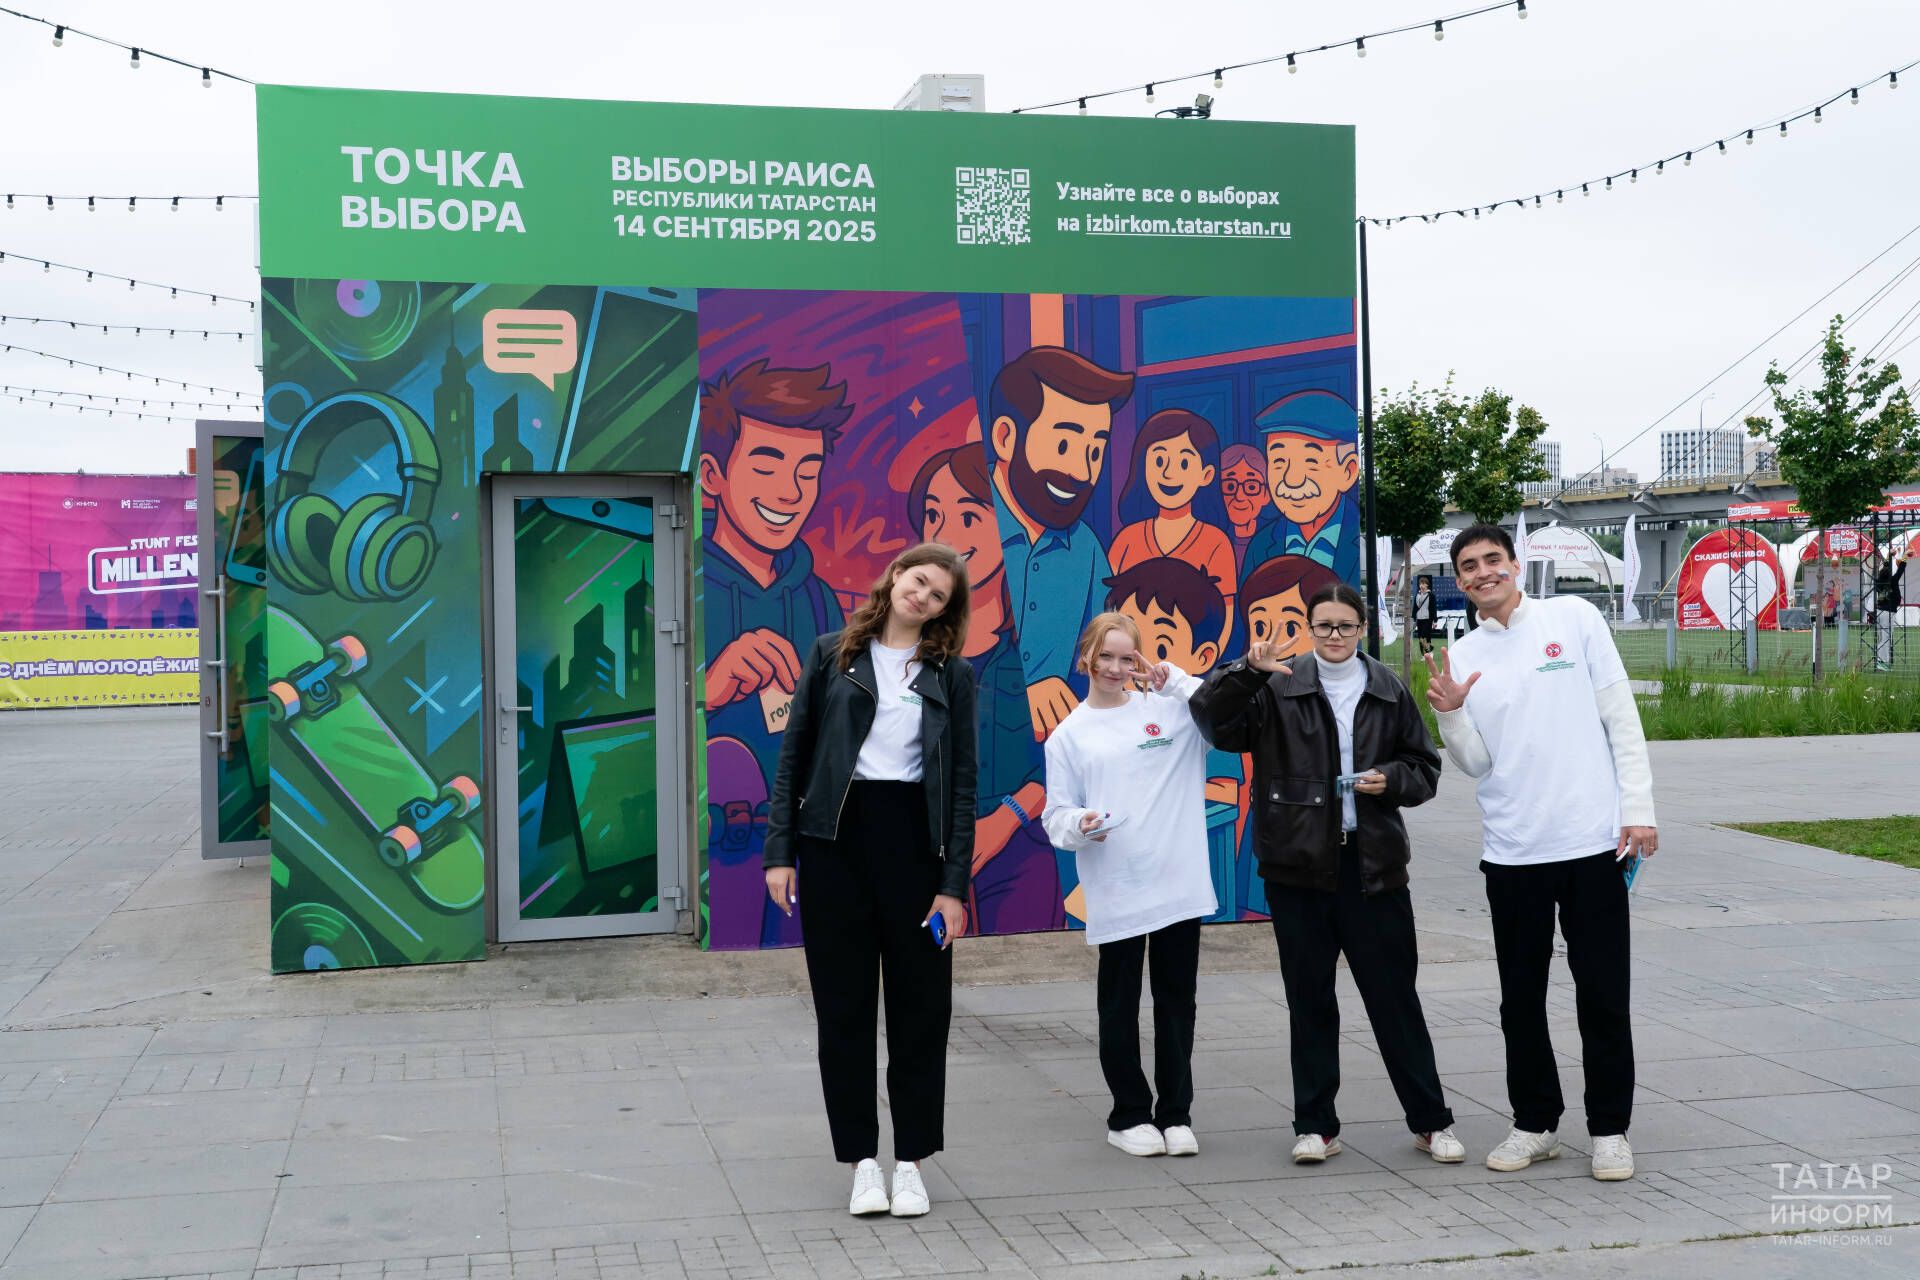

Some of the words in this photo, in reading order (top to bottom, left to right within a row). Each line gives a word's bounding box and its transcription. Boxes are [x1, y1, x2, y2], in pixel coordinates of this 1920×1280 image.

[341, 145, 524, 189] ТОЧКА
[612, 156, 757, 185] ВЫБОРЫ
[765, 161, 875, 188] РАИСА
[612, 189, 754, 209] РЕСПУБЛИКИ
[758, 193, 876, 213] ТАТАРСТАН
[1057, 181, 1136, 202] Узнайте
[1142, 188, 1175, 203] все
[1180, 189, 1192, 203] о
[1197, 185, 1280, 209] выборах
[341, 195, 527, 233] ВЫБОРА
[1057, 217, 1080, 232] на
[1086, 213, 1292, 237] izbirkom.tatarstan.ru
[613, 214, 646, 237] 14
[653, 215, 800, 241] СЕНТЯБРЯ
[807, 219, 877, 243] 2025
[130, 537, 170, 550] STUNT
[1694, 553, 1721, 562] СКАЖИ
[13, 659, 75, 679] ДНЁМ
[77, 656, 199, 676] МОЛОДЁЖИ!
